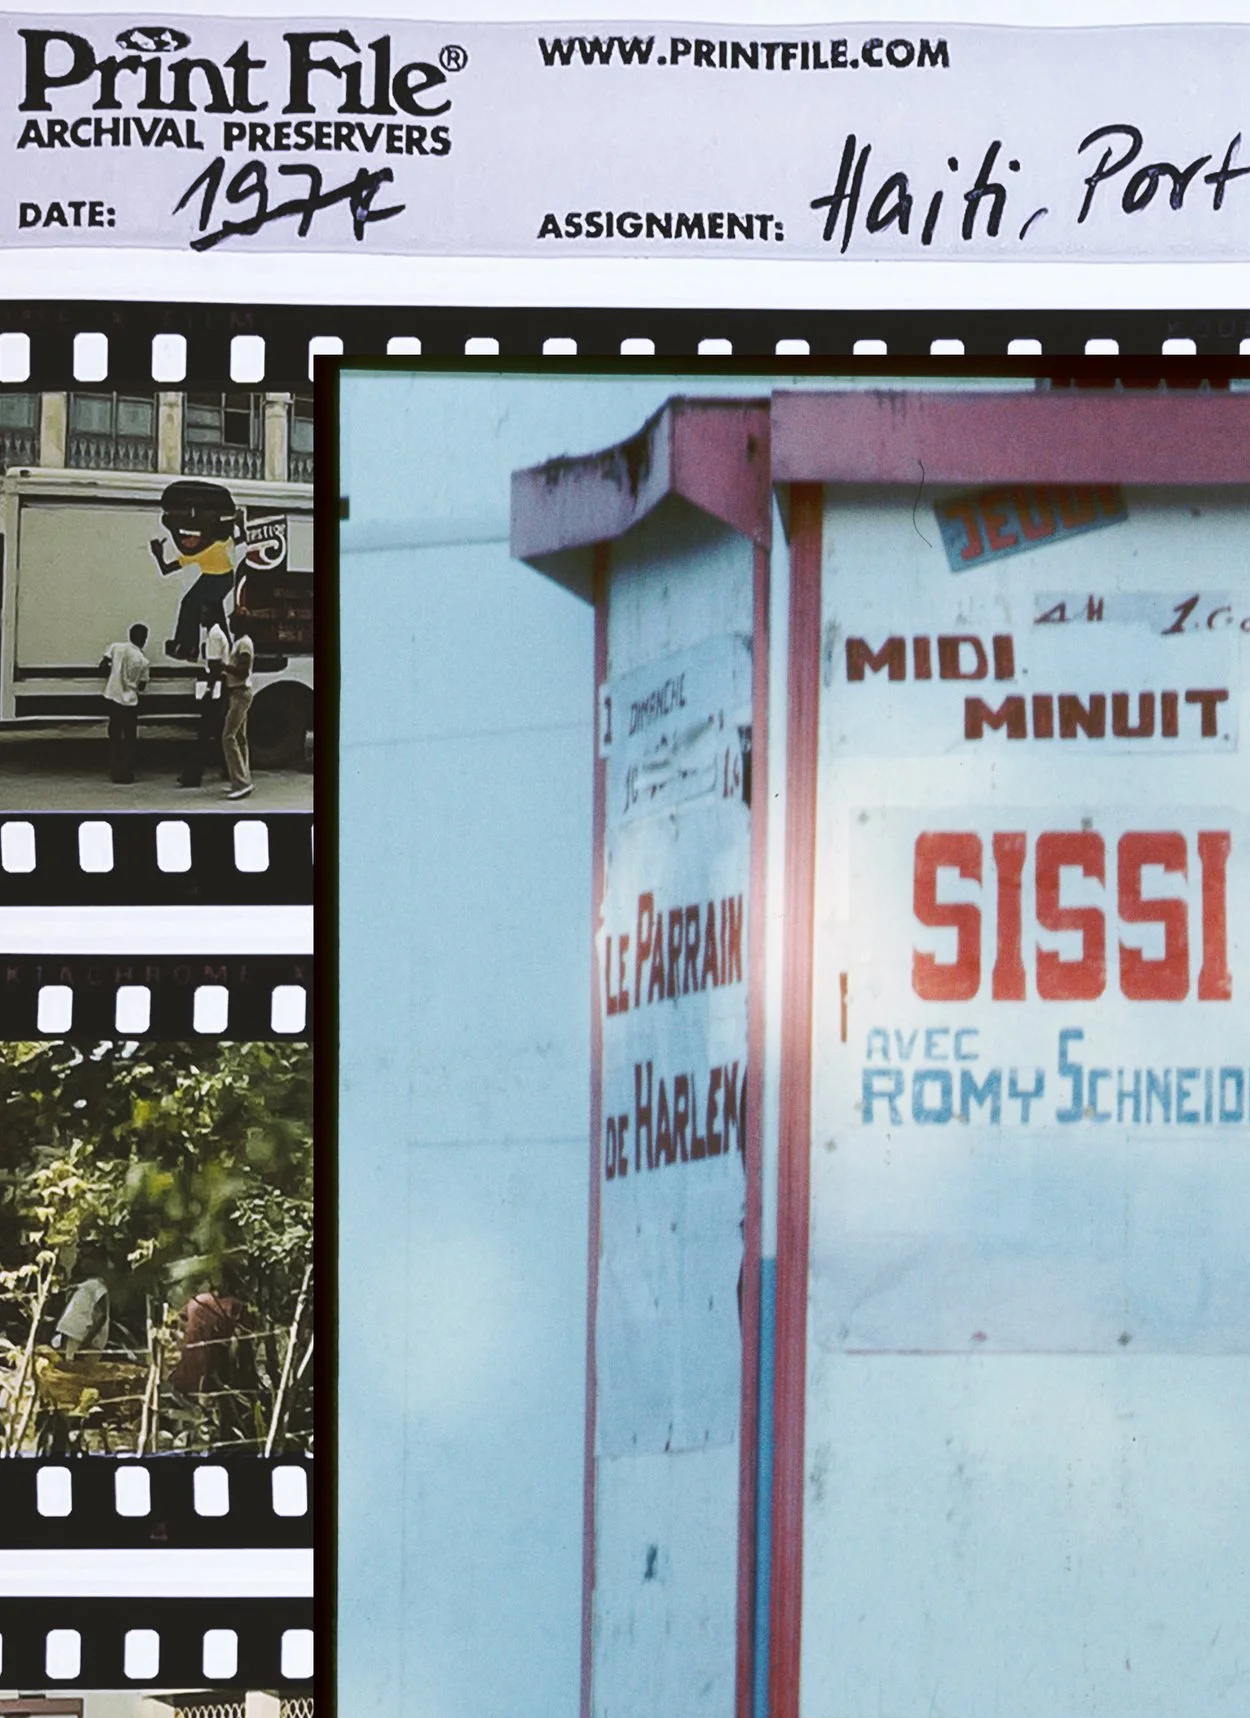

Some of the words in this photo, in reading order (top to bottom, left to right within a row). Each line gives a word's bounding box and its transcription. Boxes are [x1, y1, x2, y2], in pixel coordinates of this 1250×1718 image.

[18, 27, 268, 113] Print
[539, 37, 949, 70] WWW.PRINTFILE.COM
[17, 117, 204, 150] ARCHIVAL
[224, 121, 451, 155] PRESERVERS
[19, 201, 115, 228] DATE:
[538, 212, 783, 241] ASSIGNMENT:
[964, 688, 1230, 740] MINUIT
[911, 830, 1233, 1003] SISSI
[605, 933, 629, 1017] LE
[634, 891, 743, 1009] PARRAIN
[866, 1026, 981, 1061] AVEC
[861, 1067, 1045, 1126] ROMY
[605, 1113, 629, 1182] DE
